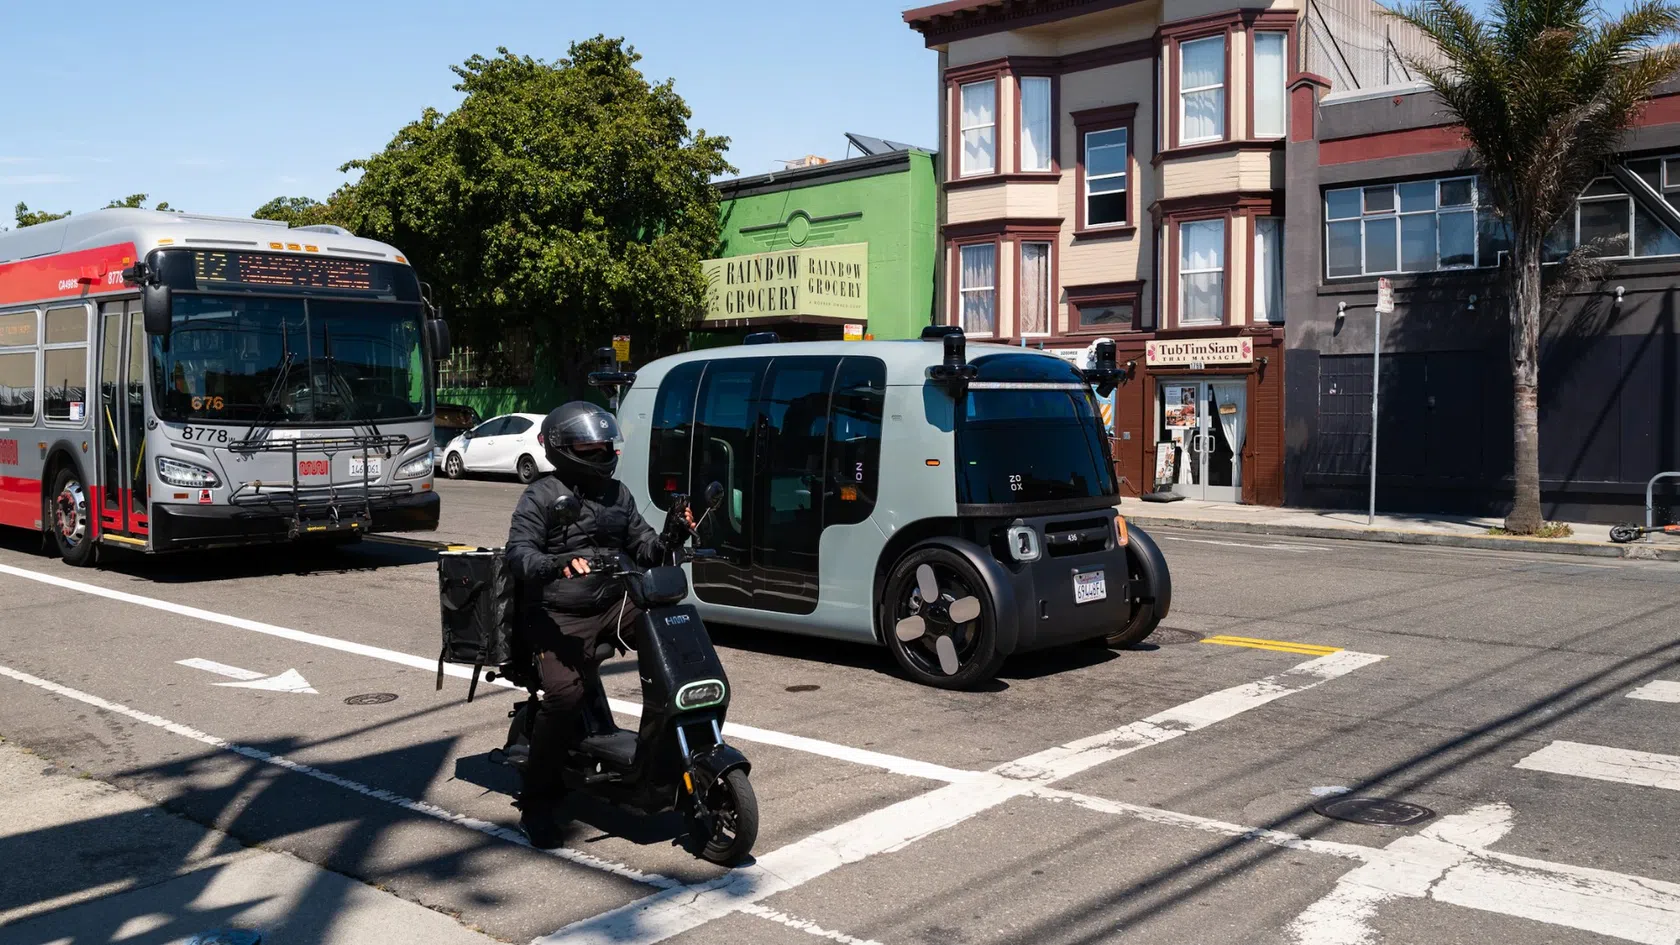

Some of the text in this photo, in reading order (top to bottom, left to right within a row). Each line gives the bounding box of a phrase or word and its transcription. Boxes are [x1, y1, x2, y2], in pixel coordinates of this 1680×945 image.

[195, 252, 227, 281] 12
[727, 255, 799, 285] RAINBOW
[808, 257, 862, 279] RAINBOW
[808, 278, 862, 298] GROCERY
[726, 286, 799, 314] GROCERY
[191, 396, 224, 410] 676
[182, 426, 228, 442] 8778
